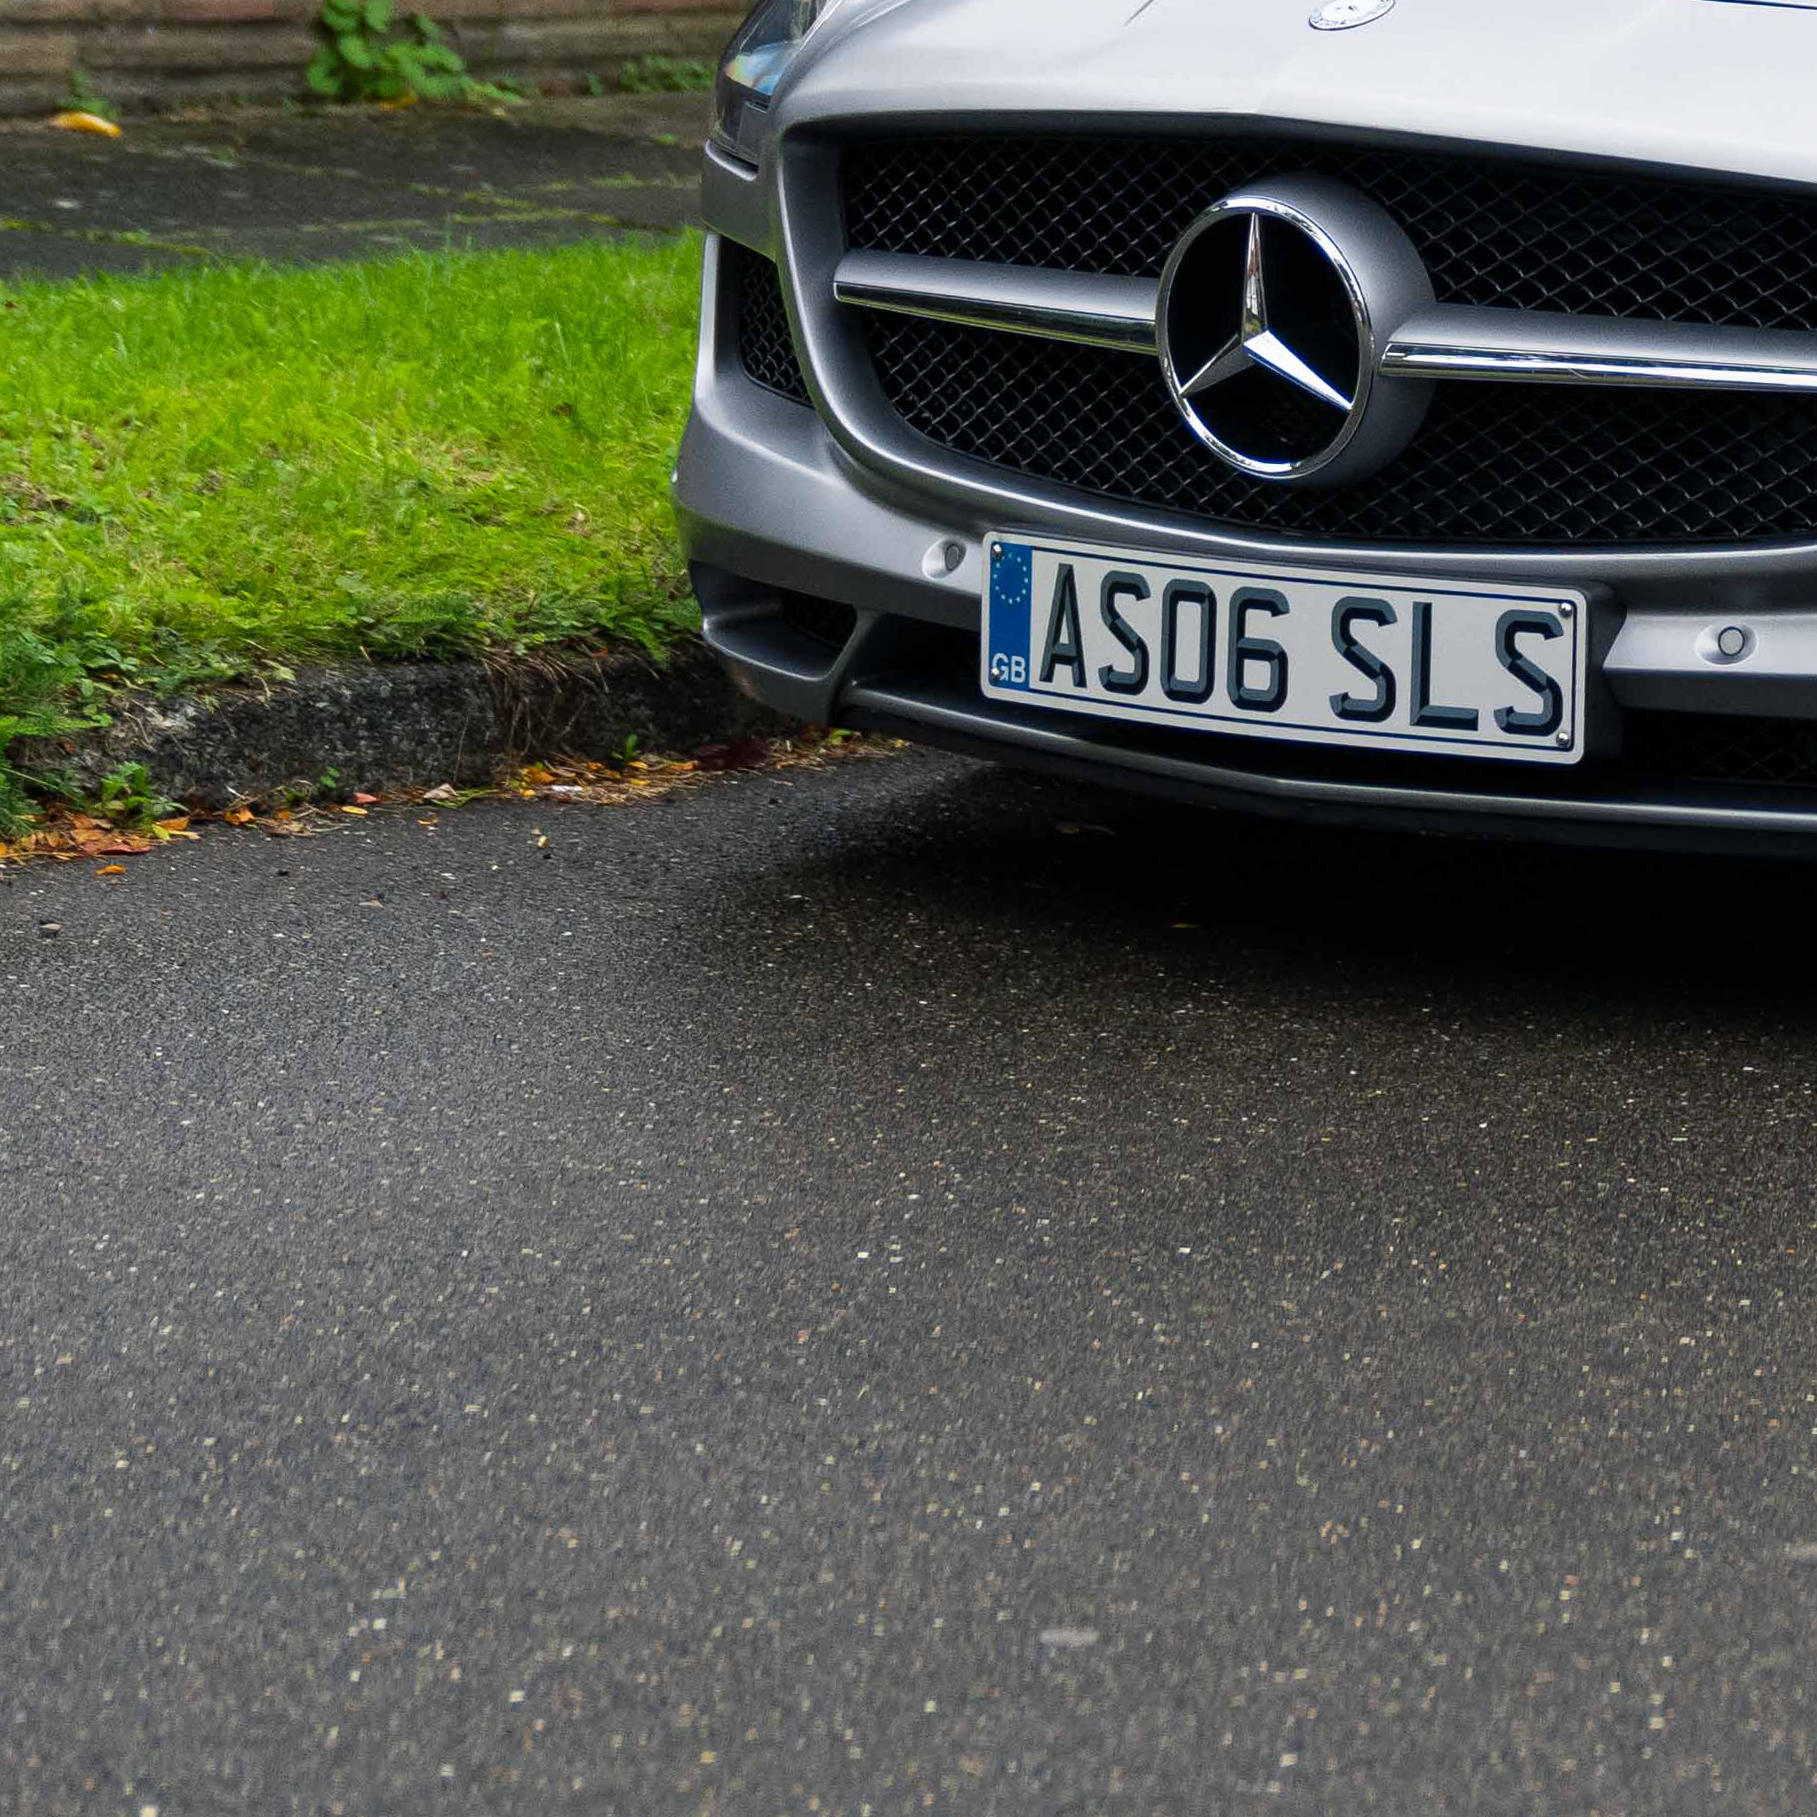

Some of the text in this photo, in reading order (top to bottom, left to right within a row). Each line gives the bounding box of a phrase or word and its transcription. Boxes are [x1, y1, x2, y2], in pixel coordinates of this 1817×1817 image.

[992, 653, 1026, 683] GB
[1039, 563, 1564, 737] AS06 SLS
